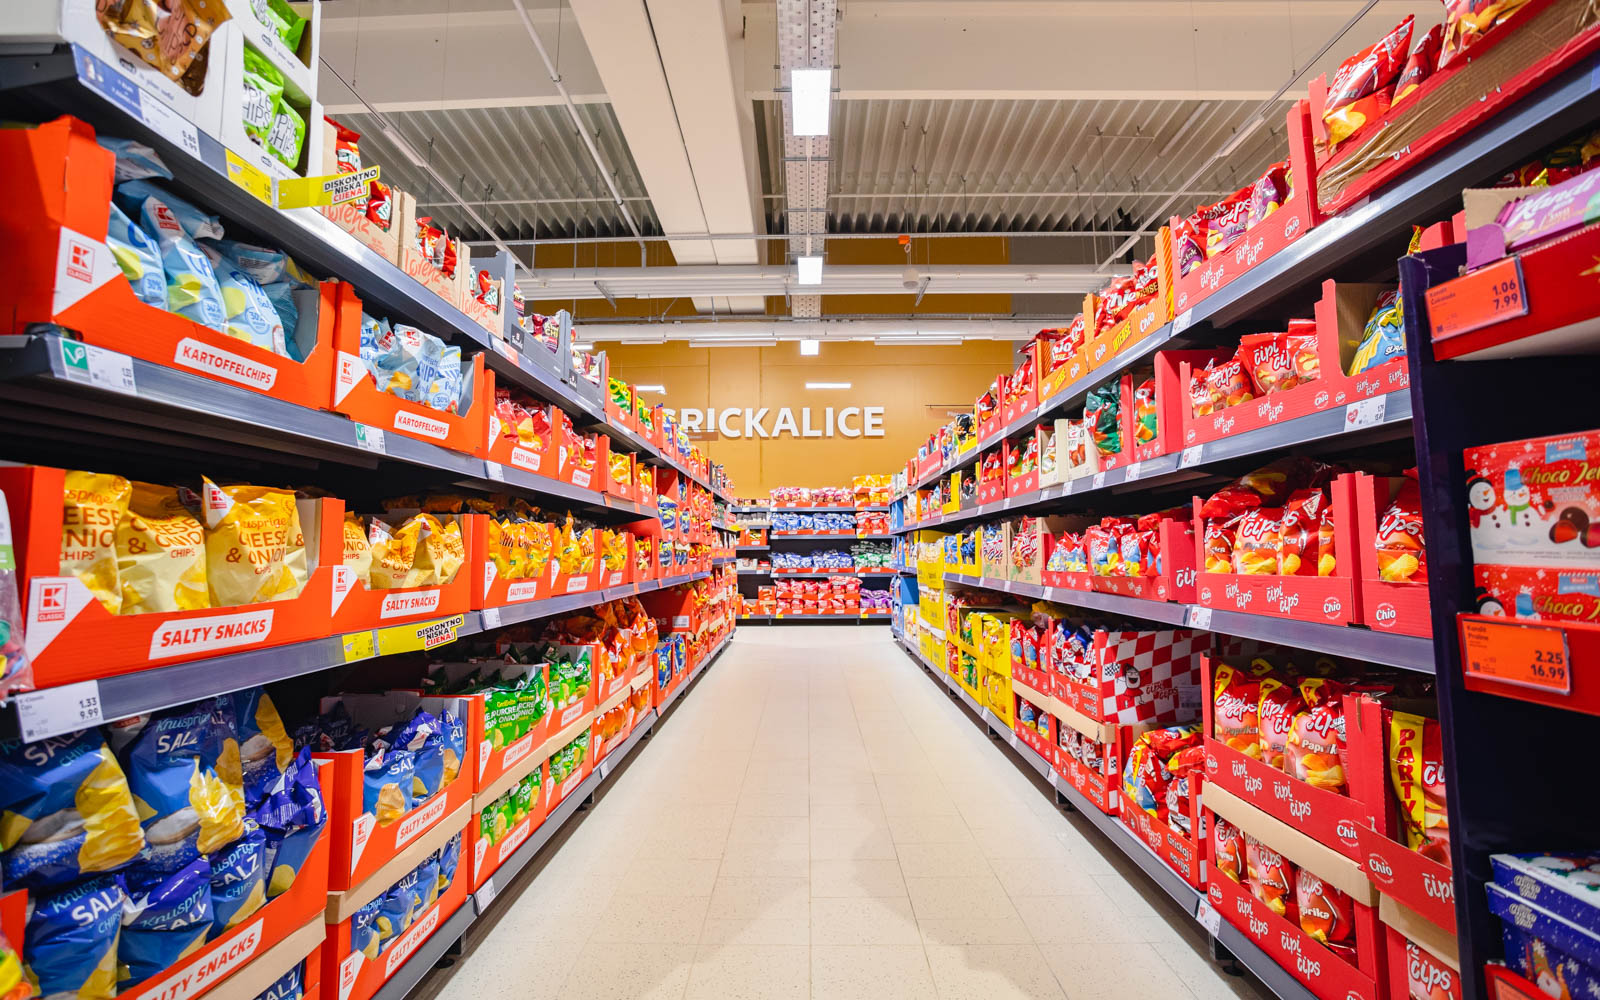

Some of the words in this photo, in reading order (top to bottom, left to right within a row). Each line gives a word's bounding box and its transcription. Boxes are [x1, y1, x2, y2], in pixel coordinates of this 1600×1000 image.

[324, 169, 377, 191] DISKONTNO
[334, 181, 361, 194] NISKA
[333, 187, 366, 202] CIJENA!
[1492, 279, 1517, 296] 1.06
[1492, 292, 1518, 311] 7.99
[1254, 337, 1279, 366] čipi
[182, 345, 272, 385] KARTOFFELCHIPS
[397, 415, 448, 435] KARTOFFELCHIPS
[1521, 466, 1570, 485] Choco
[128, 537, 148, 555] &
[225, 547, 242, 563] &
[385, 598, 409, 612] SALTY
[411, 595, 437, 608] SNACKS
[1225, 579, 1240, 599] čipi
[1236, 590, 1252, 609] čips
[1266, 580, 1283, 602] čipi
[1279, 593, 1299, 614] čips
[1323, 602, 1341, 615] Chio
[1375, 607, 1396, 622] Chio
[1532, 595, 1584, 616] Choco
[160, 627, 213, 648] SALTY
[214, 619, 267, 640] SNACKS
[417, 617, 461, 637] DISKONTNO
[426, 628, 450, 640] NISKA
[426, 631, 454, 647] CIJENA!
[1535, 649, 1563, 665] 2.25
[1530, 663, 1565, 680] 16.99
[79, 697, 97, 709] 1.33
[79, 707, 99, 720] 9.99
[1232, 759, 1248, 779] čipi
[1245, 775, 1263, 797] čips
[1397, 728, 1416, 813] PARTY
[1274, 781, 1293, 806] čipi
[1290, 797, 1312, 821] čips
[400, 819, 420, 839] SALTY
[422, 800, 444, 823] SNACKS
[1368, 858, 1393, 876] Chio
[1209, 886, 1223, 899] Chio
[1237, 896, 1254, 917] čipi
[1249, 914, 1269, 939] čips
[390, 941, 411, 967] SALTY
[412, 914, 437, 941] SNACKS
[196, 932, 256, 983] SNACKS
[1280, 930, 1302, 954] čipi
[1296, 953, 1321, 980] čips
[1410, 953, 1452, 993] čips
